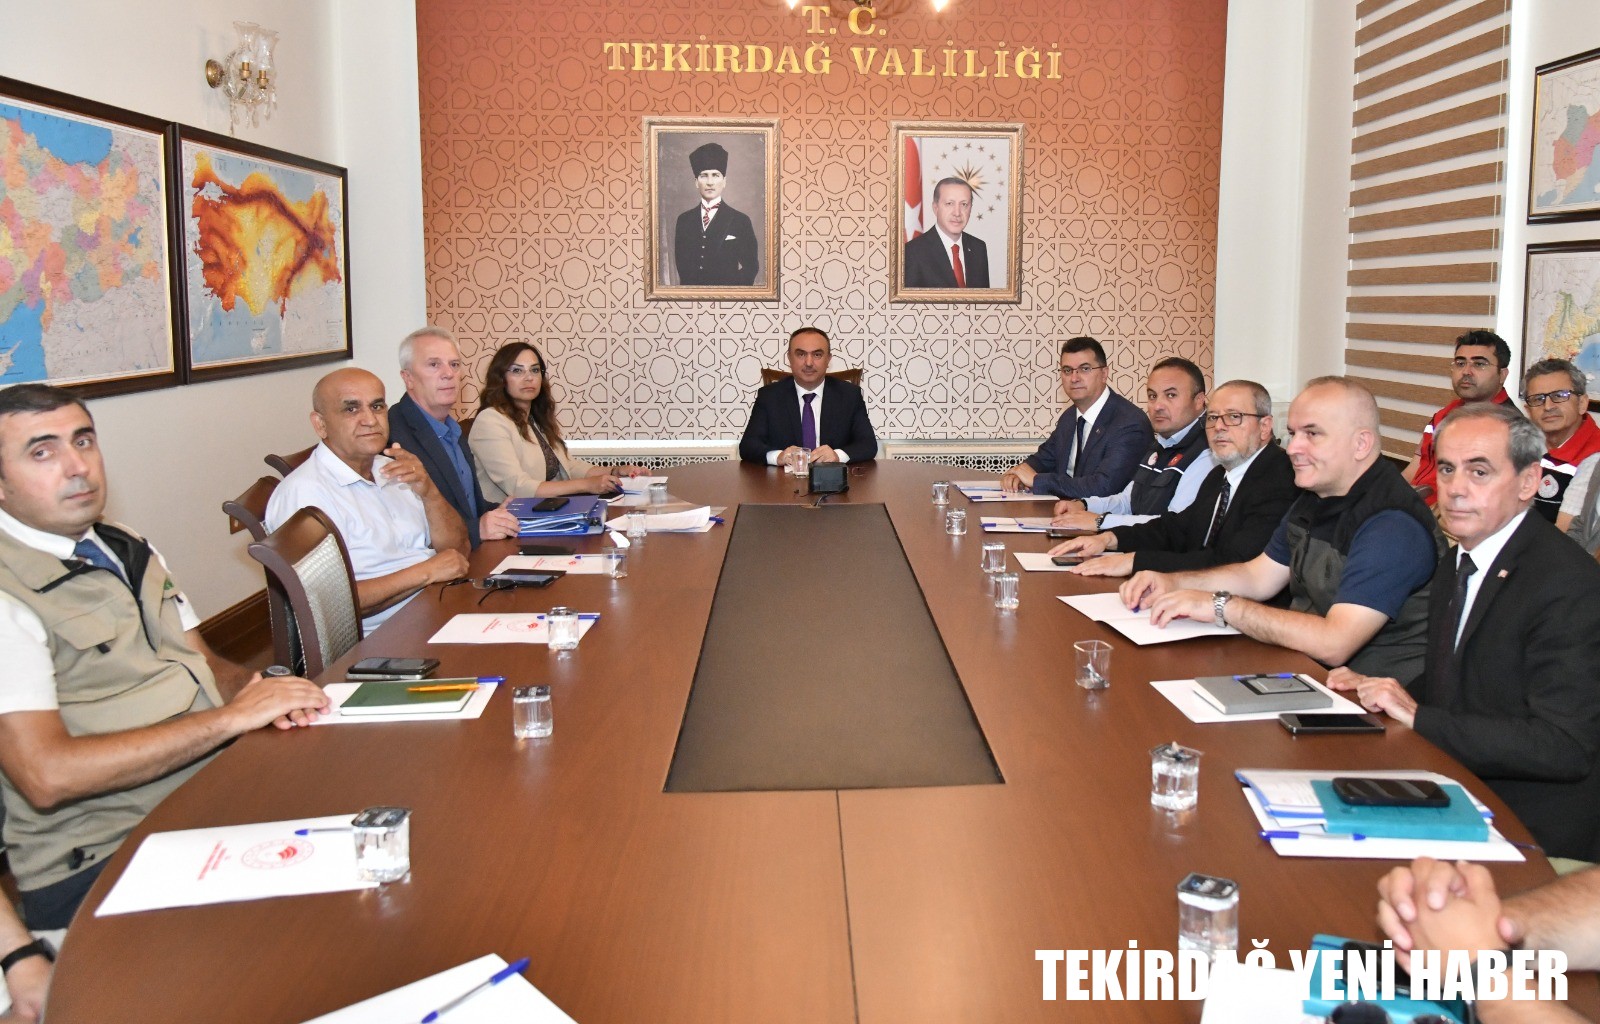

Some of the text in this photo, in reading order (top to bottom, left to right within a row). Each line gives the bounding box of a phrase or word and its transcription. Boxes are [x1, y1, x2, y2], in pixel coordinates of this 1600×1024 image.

[801, 5, 887, 36] T. C.
[603, 34, 1063, 79] TEKİRDAĞ VALİLİĞİ
